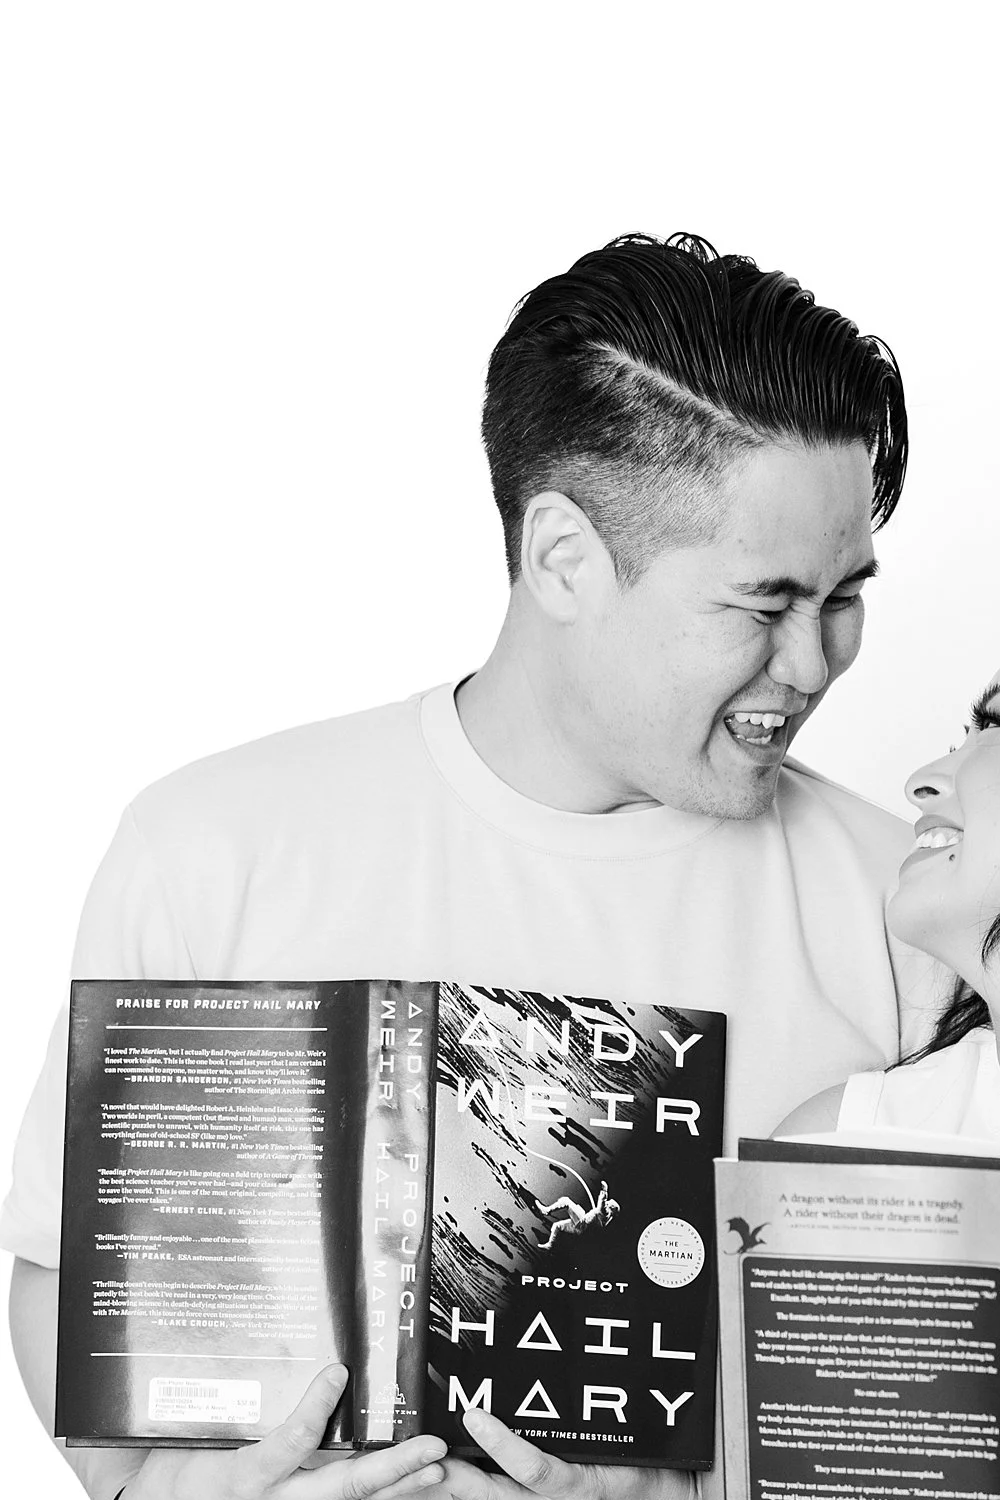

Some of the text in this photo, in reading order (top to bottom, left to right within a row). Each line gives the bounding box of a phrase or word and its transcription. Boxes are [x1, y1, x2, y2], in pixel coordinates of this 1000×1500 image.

[116, 998, 321, 1010] PRAISE FOR PROJECT HAIL MARY
[377, 1000, 396, 1101] WEIR
[405, 1000, 423, 1100] ANDY
[459, 1008, 703, 1068] ANDY
[457, 1077, 700, 1136] WEIR
[153, 1206, 226, 1216] —ERNEST CLINE,
[374, 1142, 392, 1235] HAIL
[399, 1153, 419, 1338] PROJECT
[649, 1249, 693, 1260] MARTIAN
[370, 1260, 386, 1352] MARY
[521, 1275, 629, 1294] PROJECT
[451, 1306, 696, 1361] HAIL
[448, 1375, 695, 1427] MARY
[525, 1429, 548, 1438] YORK
[550, 1430, 578, 1440] TIMES
[580, 1432, 634, 1443] BESTSELLER
